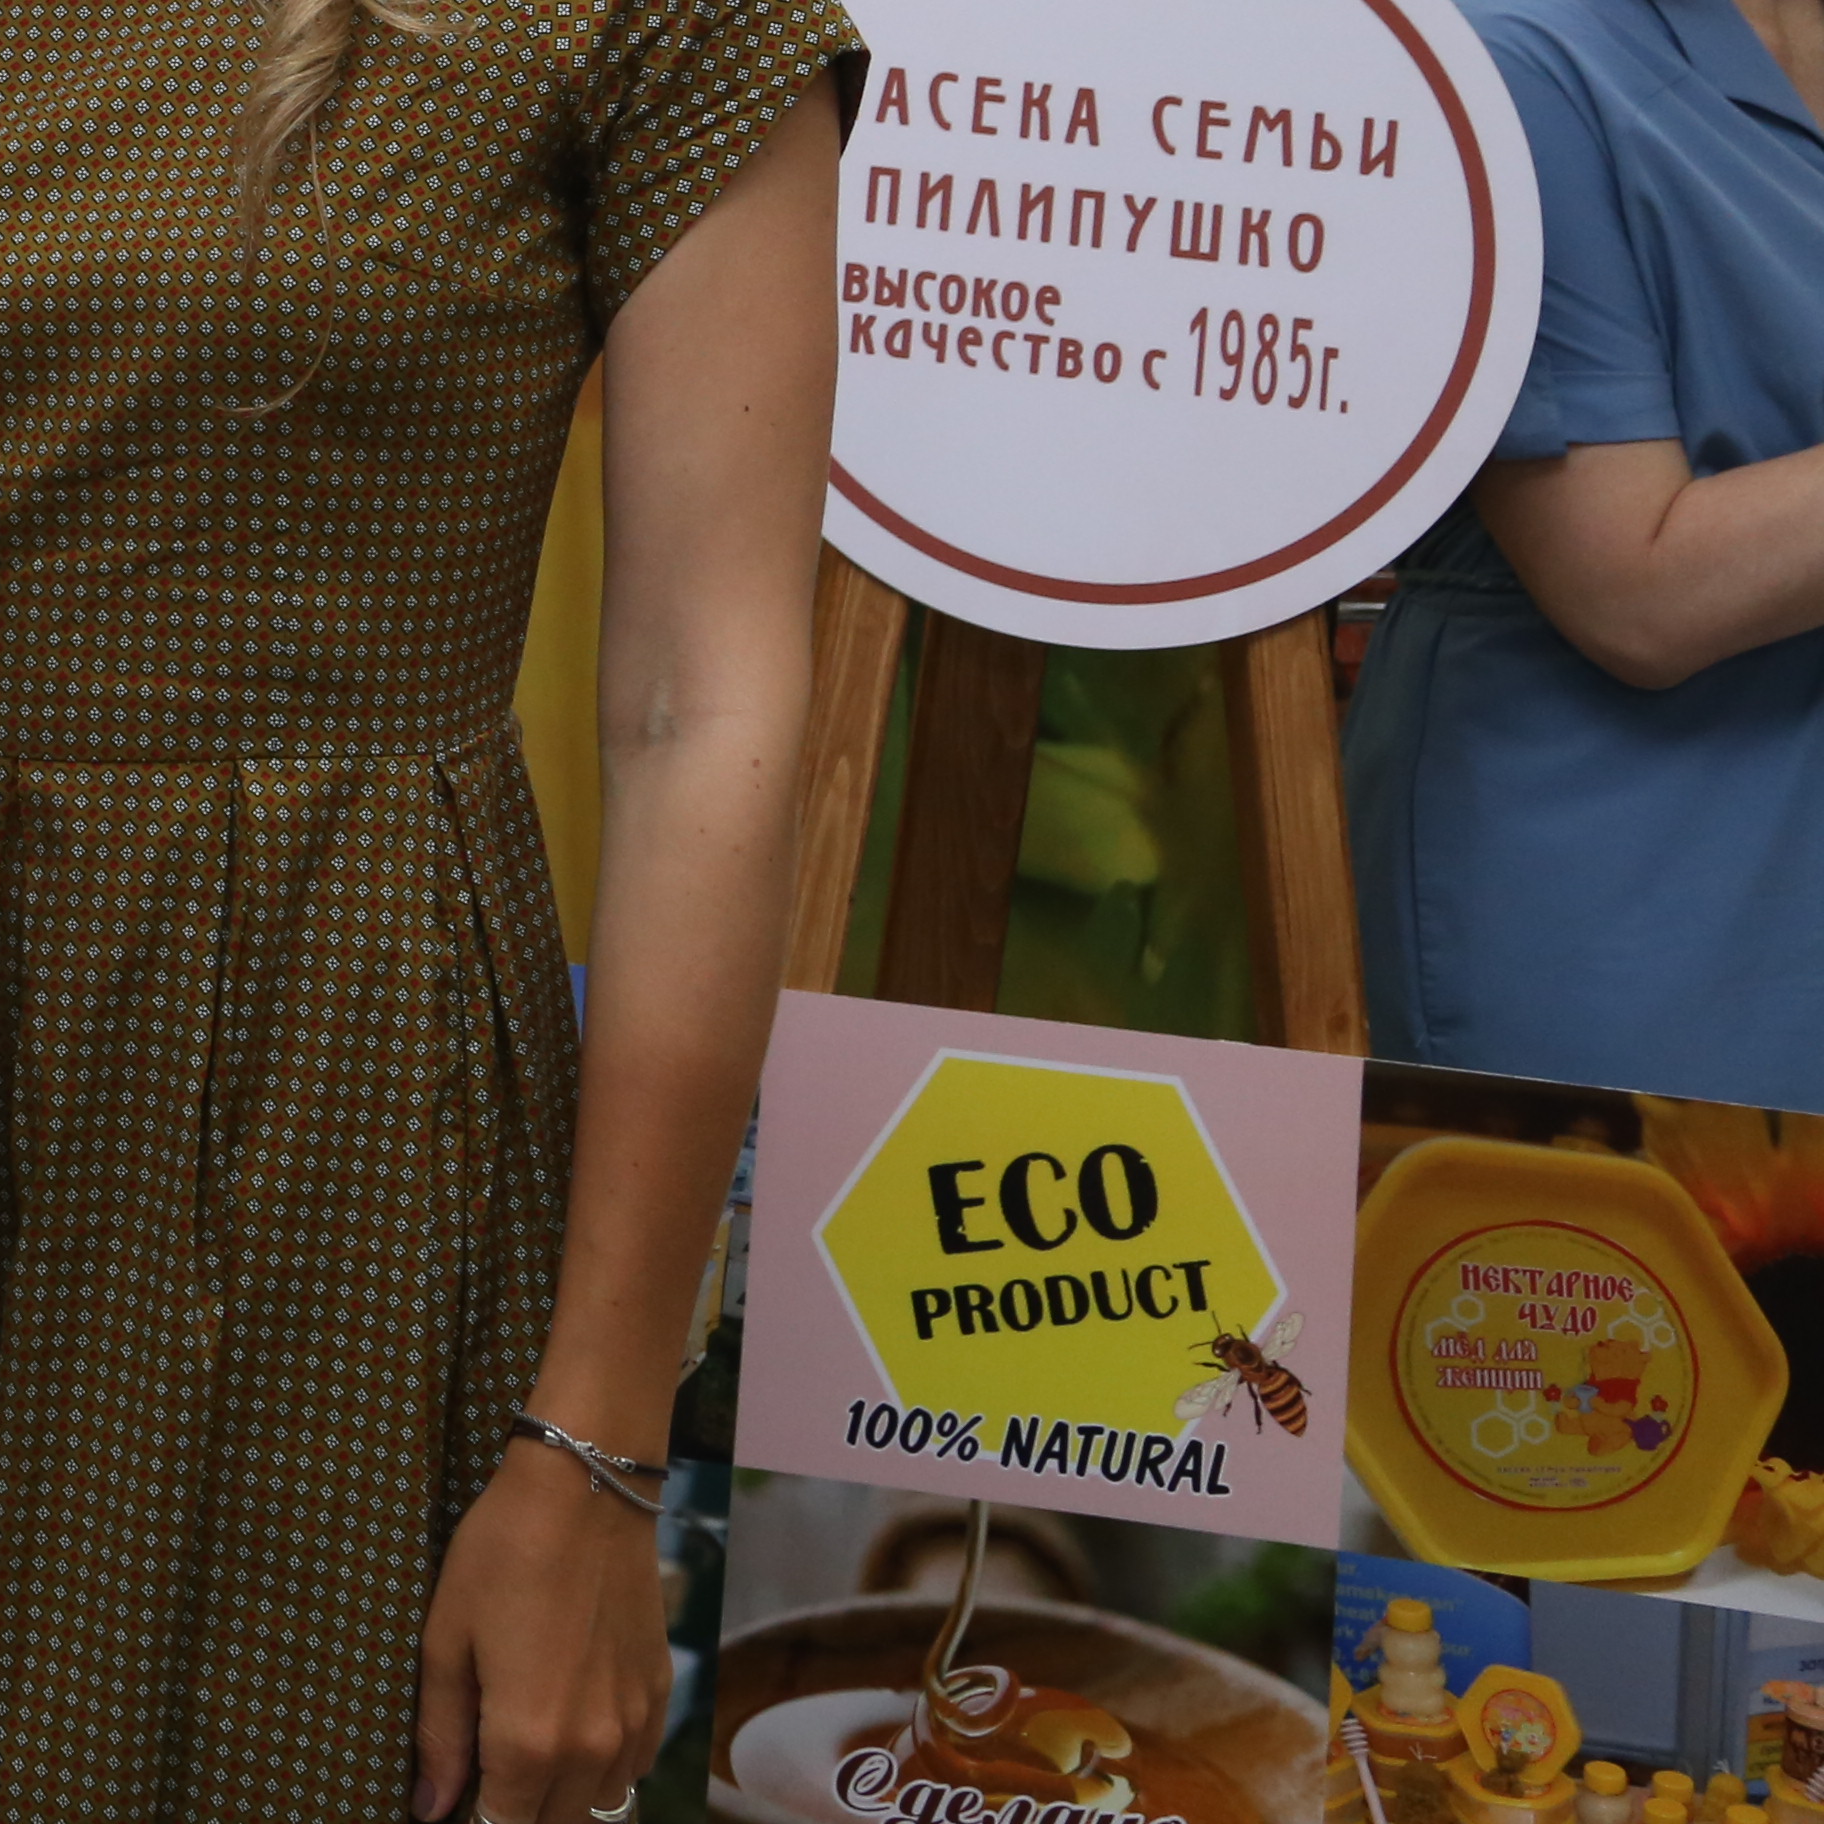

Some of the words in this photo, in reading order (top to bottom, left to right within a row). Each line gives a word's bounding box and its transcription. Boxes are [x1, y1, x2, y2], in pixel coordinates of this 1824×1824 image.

[874, 66, 1101, 148] АСЕКА
[1151, 95, 1401, 179] СЕМЬИ
[864, 165, 1327, 274] ПИЛИПУШКО
[1188, 306, 1350, 415] 1985г.
[927, 1143, 1159, 1255] ECO
[910, 1259, 1211, 1341] PRODUCT
[1460, 1261, 1636, 1304] НЕКТАРНОЕ
[1518, 1302, 1599, 1337] ЧУДО
[844, 1398, 984, 1463] 100%
[1000, 1416, 1232, 1496] NATURAL
